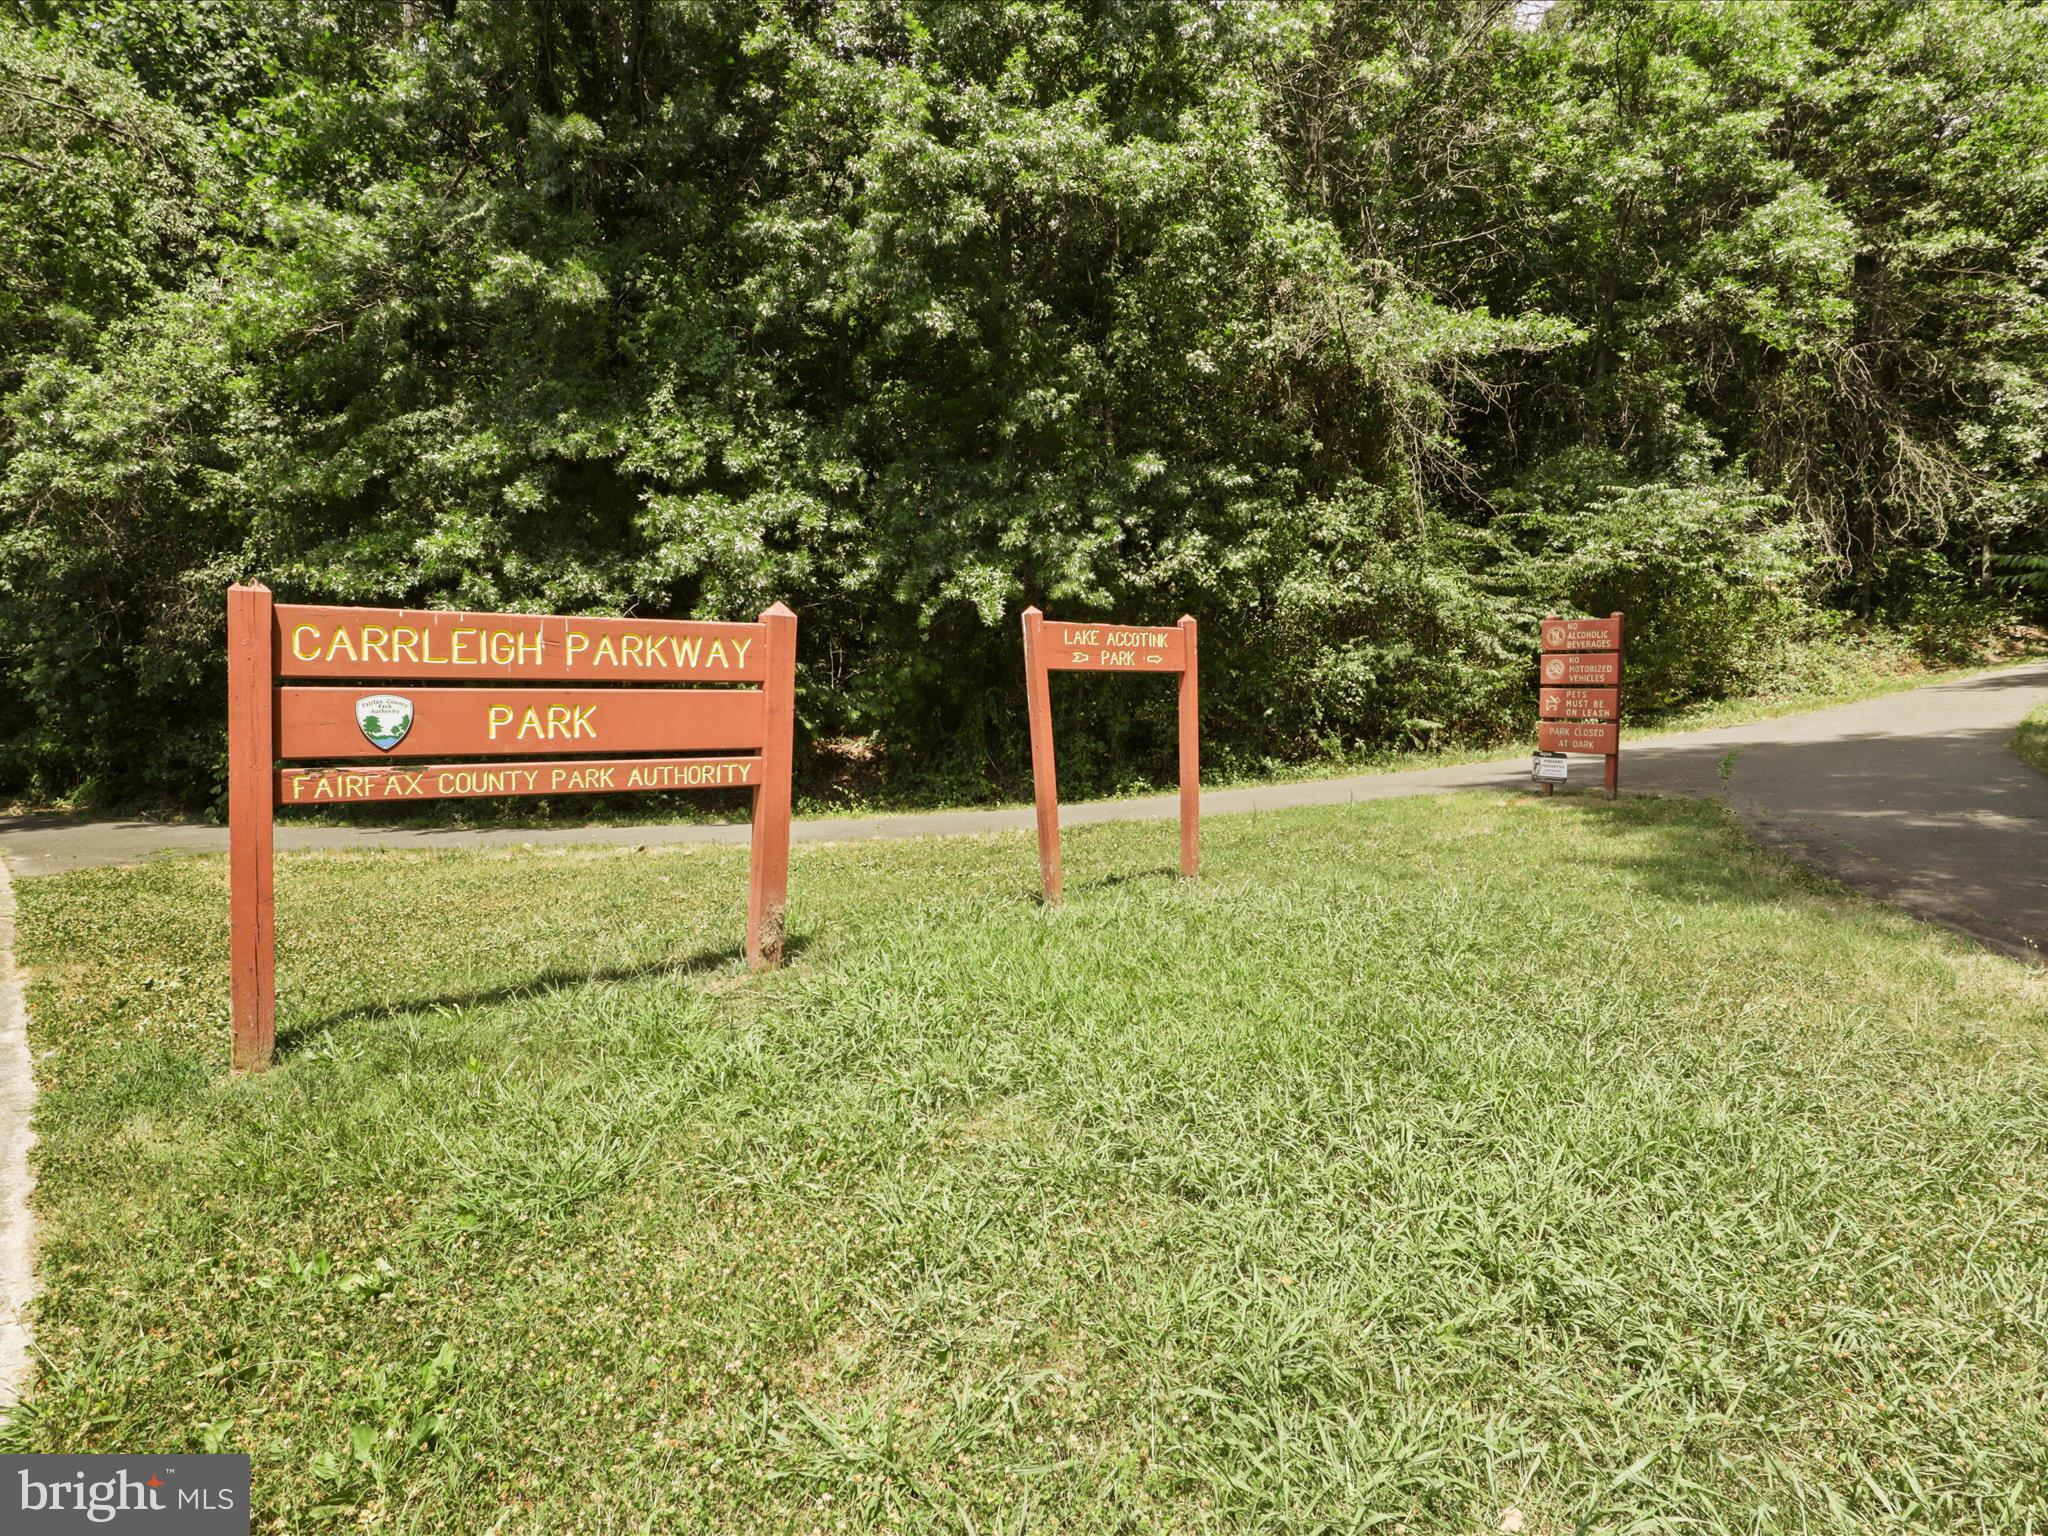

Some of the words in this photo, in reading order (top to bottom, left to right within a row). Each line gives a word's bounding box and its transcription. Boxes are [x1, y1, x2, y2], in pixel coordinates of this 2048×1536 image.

[1567, 623, 1578, 631] NO
[1064, 629, 1100, 646] LAKE
[1106, 632, 1168, 648] ACCOTINK
[1567, 630, 1609, 640] ALCOHOLIC
[292, 623, 543, 666] CARRLEIGH
[565, 631, 752, 669] PARKWAY
[1567, 639, 1611, 649] BEVERAGES
[1101, 650, 1136, 666] PARK
[1569, 656, 1580, 664] NO
[1569, 664, 1612, 673] MOTORIZED
[1569, 673, 1605, 682] VEHICLES
[1566, 690, 1587, 699] PETS
[1566, 699, 1589, 708] MUST
[1593, 700, 1604, 709] BE
[1566, 708, 1578, 717] ON
[1582, 709, 1610, 718] LEASH
[488, 704, 598, 741] PARK
[1549, 727, 1570, 737] PARK
[1574, 728, 1605, 737] CLOSED
[1558, 739, 1569, 748] AT
[1573, 740, 1594, 749] DARK
[292, 770, 424, 800] FAIRFAX
[438, 770, 537, 795] COUNTY
[552, 767, 614, 790] PARK
[627, 763, 751, 786] AUTHORITY
